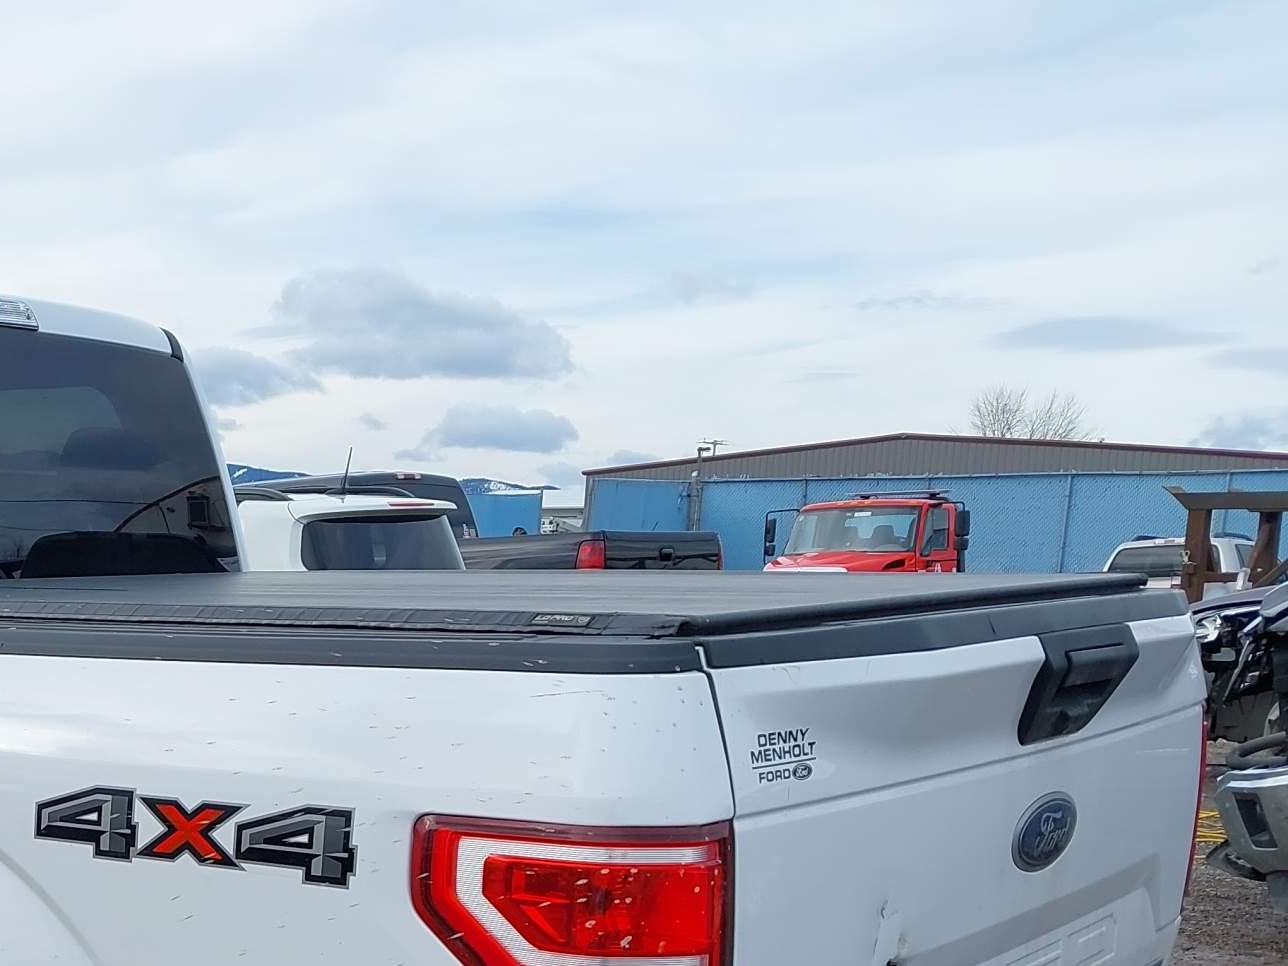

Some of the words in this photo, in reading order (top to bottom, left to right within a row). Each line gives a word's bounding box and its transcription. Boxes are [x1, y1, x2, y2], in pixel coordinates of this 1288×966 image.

[757, 727, 810, 748] DENNY
[750, 741, 817, 765] MENHOLT
[758, 767, 792, 785] FORD
